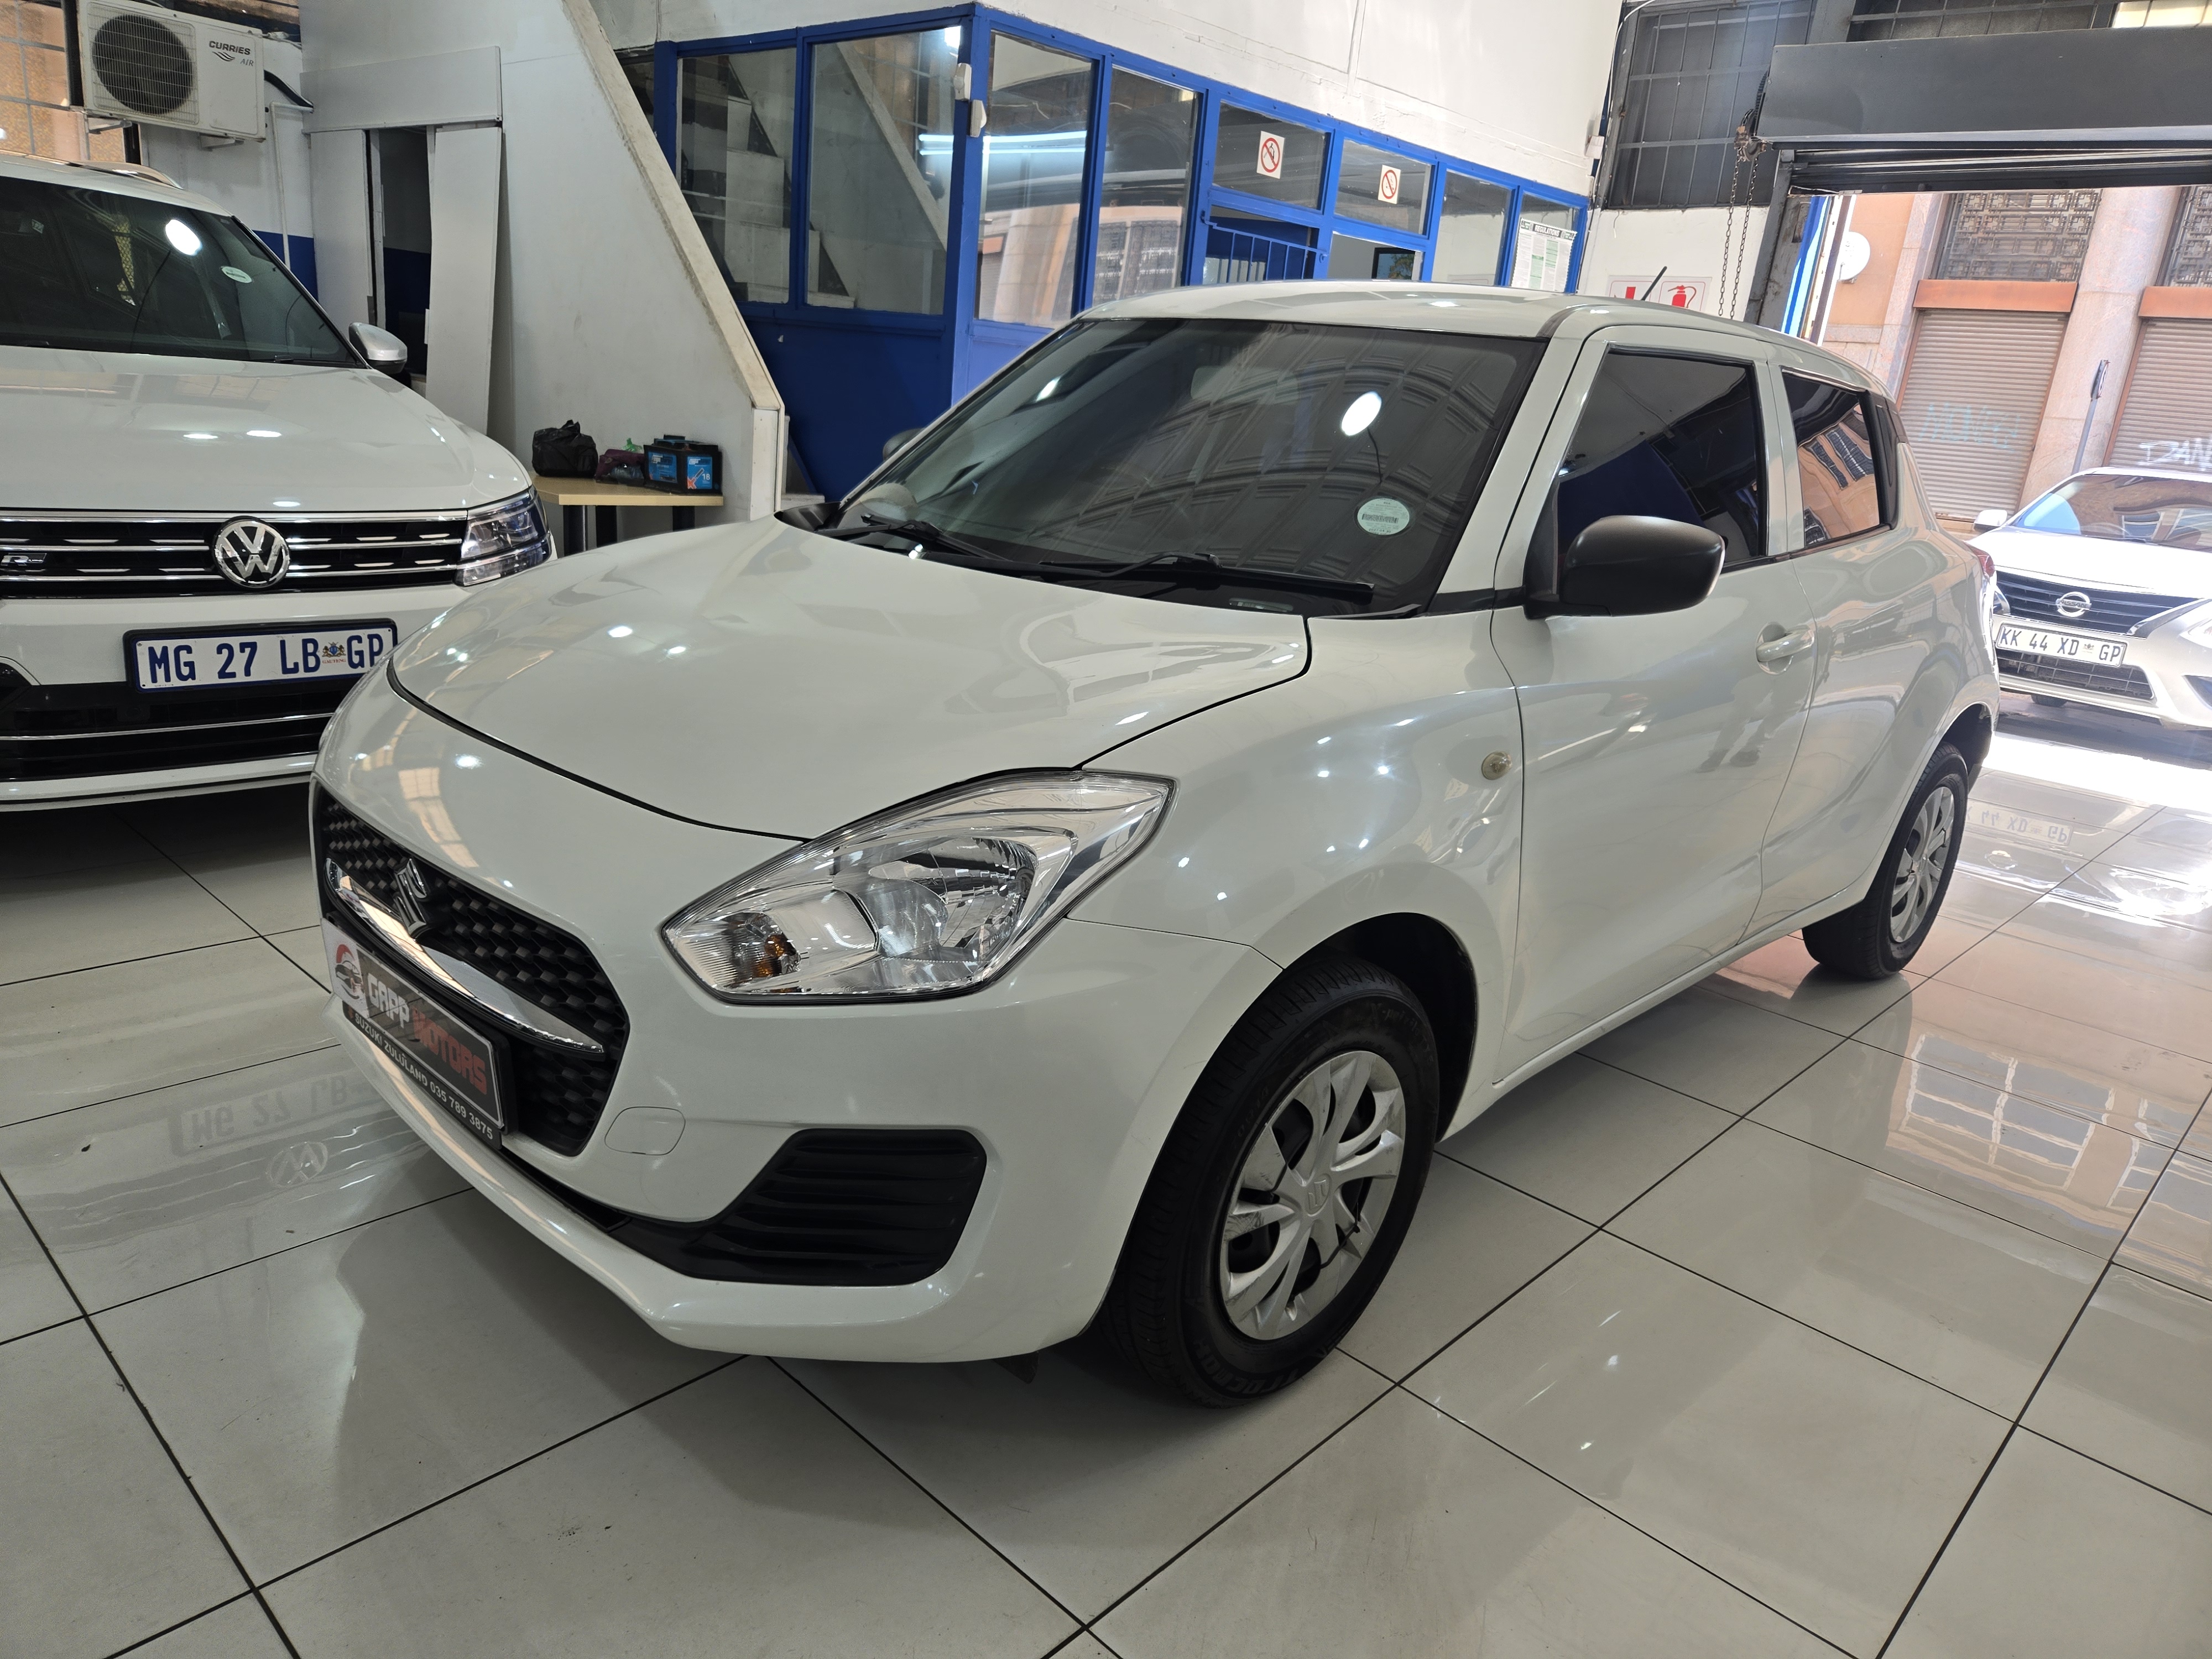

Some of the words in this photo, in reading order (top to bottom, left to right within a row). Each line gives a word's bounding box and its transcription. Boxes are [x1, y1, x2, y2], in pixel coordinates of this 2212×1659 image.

[209, 40, 251, 55] CURRIES
[239, 58, 254, 67] AIR
[1535, 225, 1560, 237] REGULATIONS
[2060, 599, 2089, 608] NISSAN
[2000, 627, 2022, 646] KK
[2029, 633, 2048, 651] 44
[2057, 637, 2079, 655] XD
[2099, 644, 2121, 662] GP
[148, 645, 196, 684] MG
[216, 641, 258, 679] 27
[280, 638, 321, 675] LB
[346, 634, 384, 669] GP
[368, 973, 410, 1029] GAPP
[412, 1006, 488, 1095] MOTORS
[355, 1013, 383, 1046] SUZUKI
[430, 1081, 447, 1103] 035
[448, 1096, 467, 1118] 789
[469, 1112, 493, 1140] 3875
